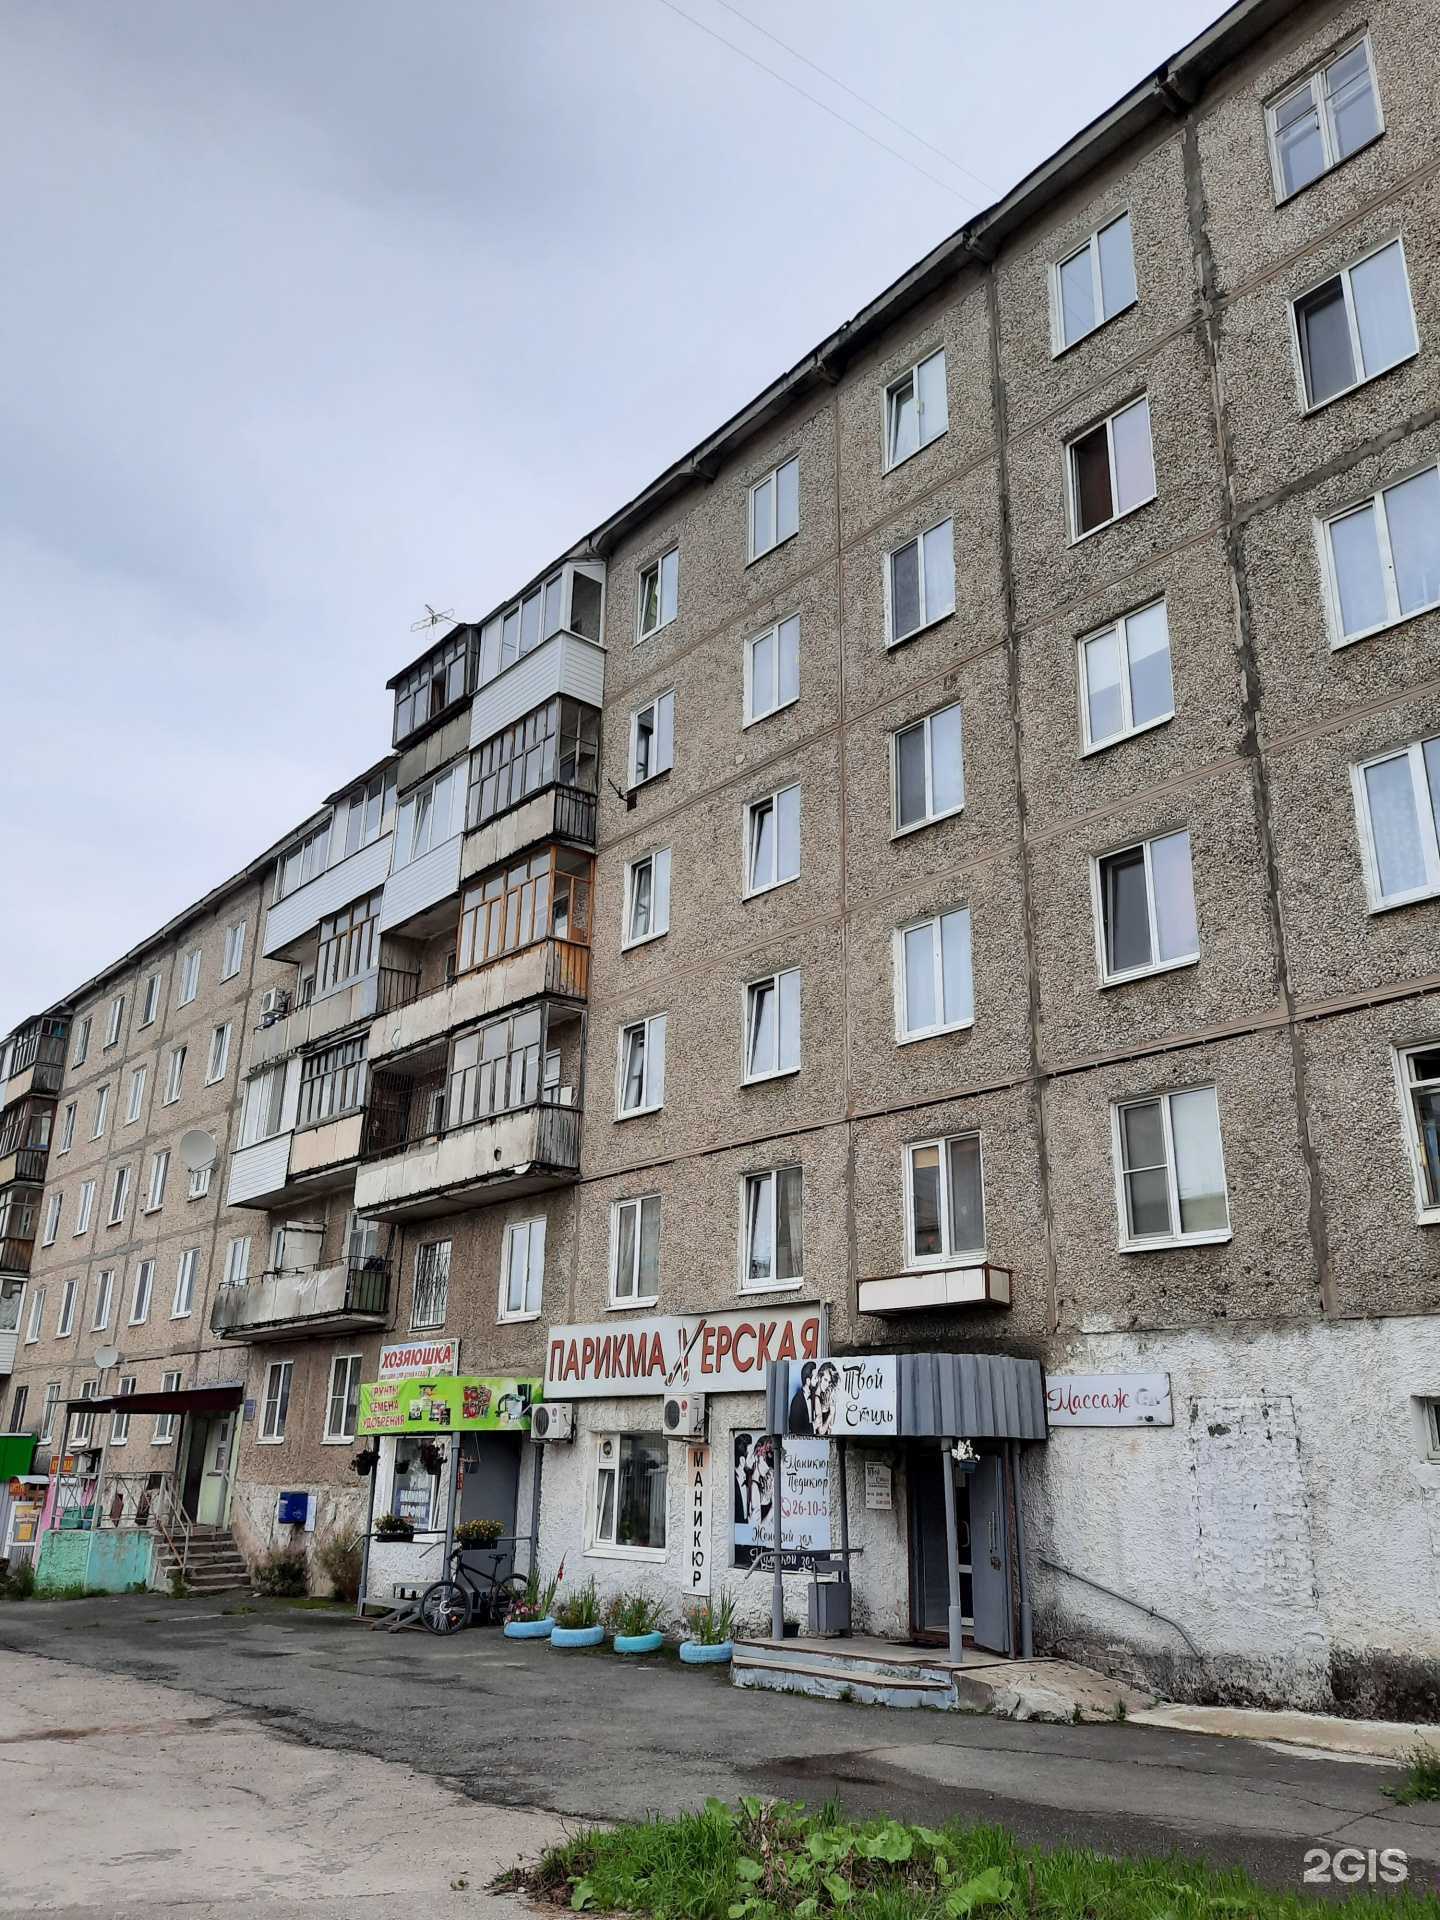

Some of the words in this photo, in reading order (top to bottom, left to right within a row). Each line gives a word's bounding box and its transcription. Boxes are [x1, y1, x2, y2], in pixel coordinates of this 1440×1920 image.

[381, 1345, 452, 1369] ХОЗЯЮШКА
[842, 1363, 884, 1400] Твой
[370, 1400, 399, 1413] СЕМЕНА
[1045, 1384, 1130, 1415] Массаж
[845, 1401, 894, 1427] Стиль
[786, 1473, 828, 1496] Педикюр
[691, 1451, 704, 1587] МАНИКЮР
